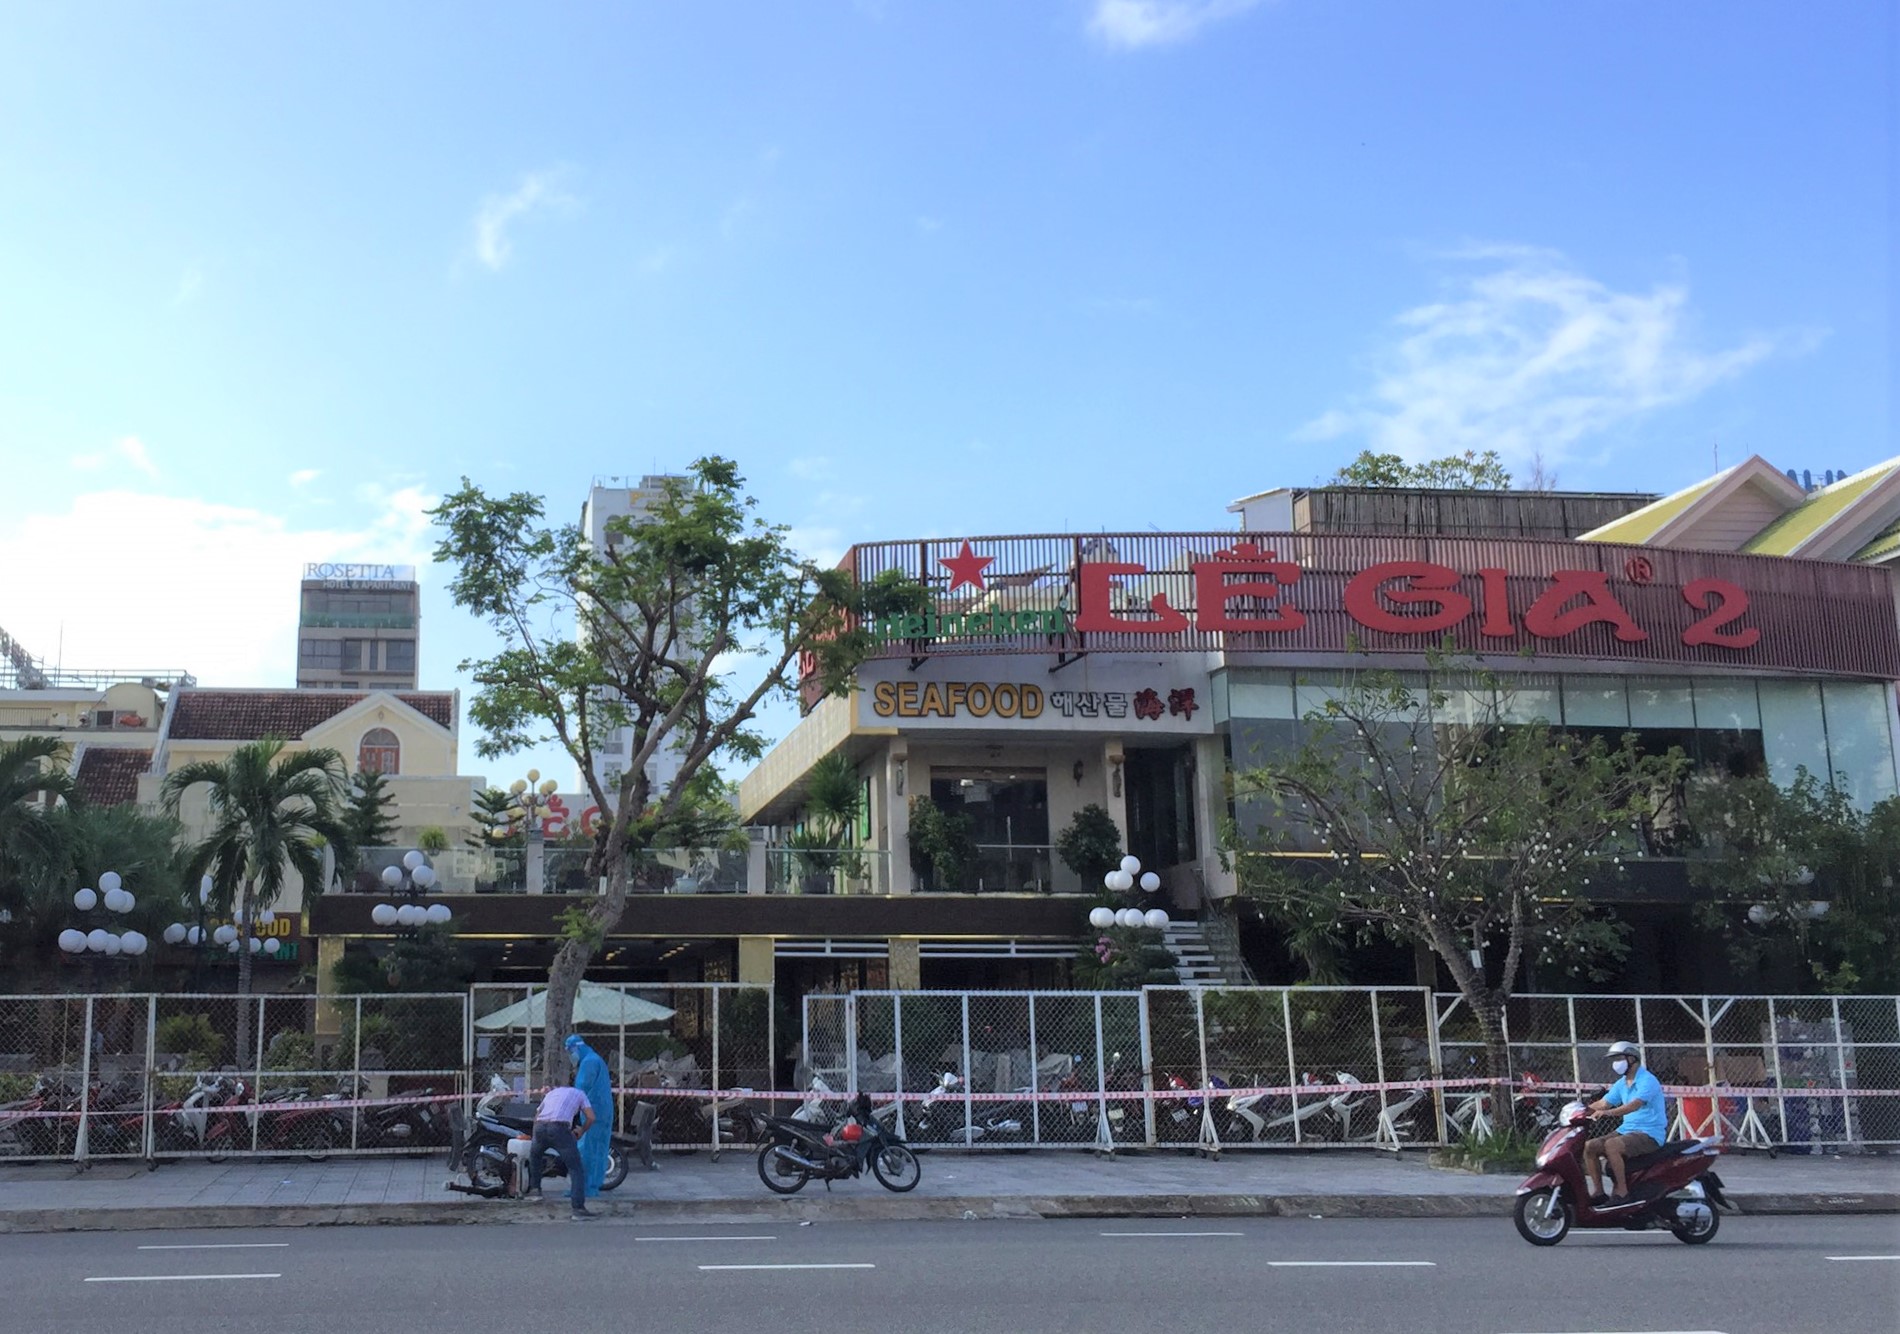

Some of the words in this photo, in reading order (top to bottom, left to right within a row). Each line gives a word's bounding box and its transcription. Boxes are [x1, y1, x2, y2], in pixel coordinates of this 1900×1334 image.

[306, 563, 396, 579] ROSETTA
[322, 580, 351, 590] HOTEL
[361, 581, 412, 591] APARTMENT
[1343, 560, 1649, 642] GIA
[1681, 578, 1761, 649] 2
[873, 681, 1044, 719] SEAFOOD
[1050, 691, 1128, 719] 해산물
